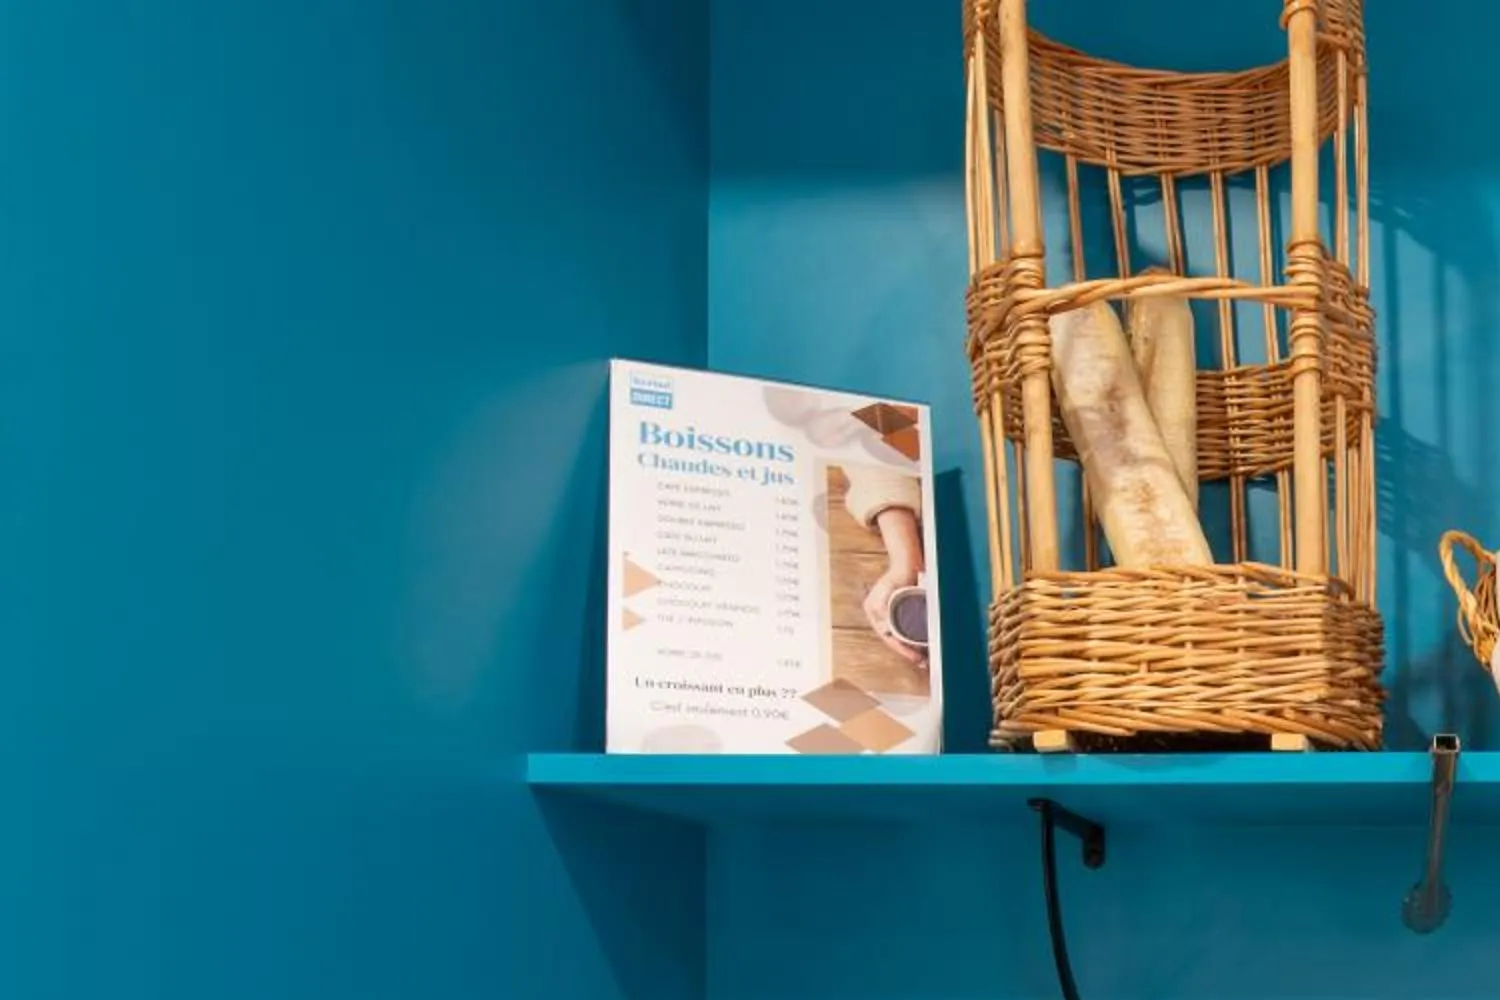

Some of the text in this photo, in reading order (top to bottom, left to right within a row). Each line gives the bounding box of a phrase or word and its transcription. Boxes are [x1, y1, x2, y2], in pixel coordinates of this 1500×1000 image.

[639, 420, 795, 463] Boissons
[637, 452, 795, 486] Chaudes et jus
[657, 679, 724, 695] croissant
[727, 685, 746, 696] en
[748, 684, 778, 700] plus
